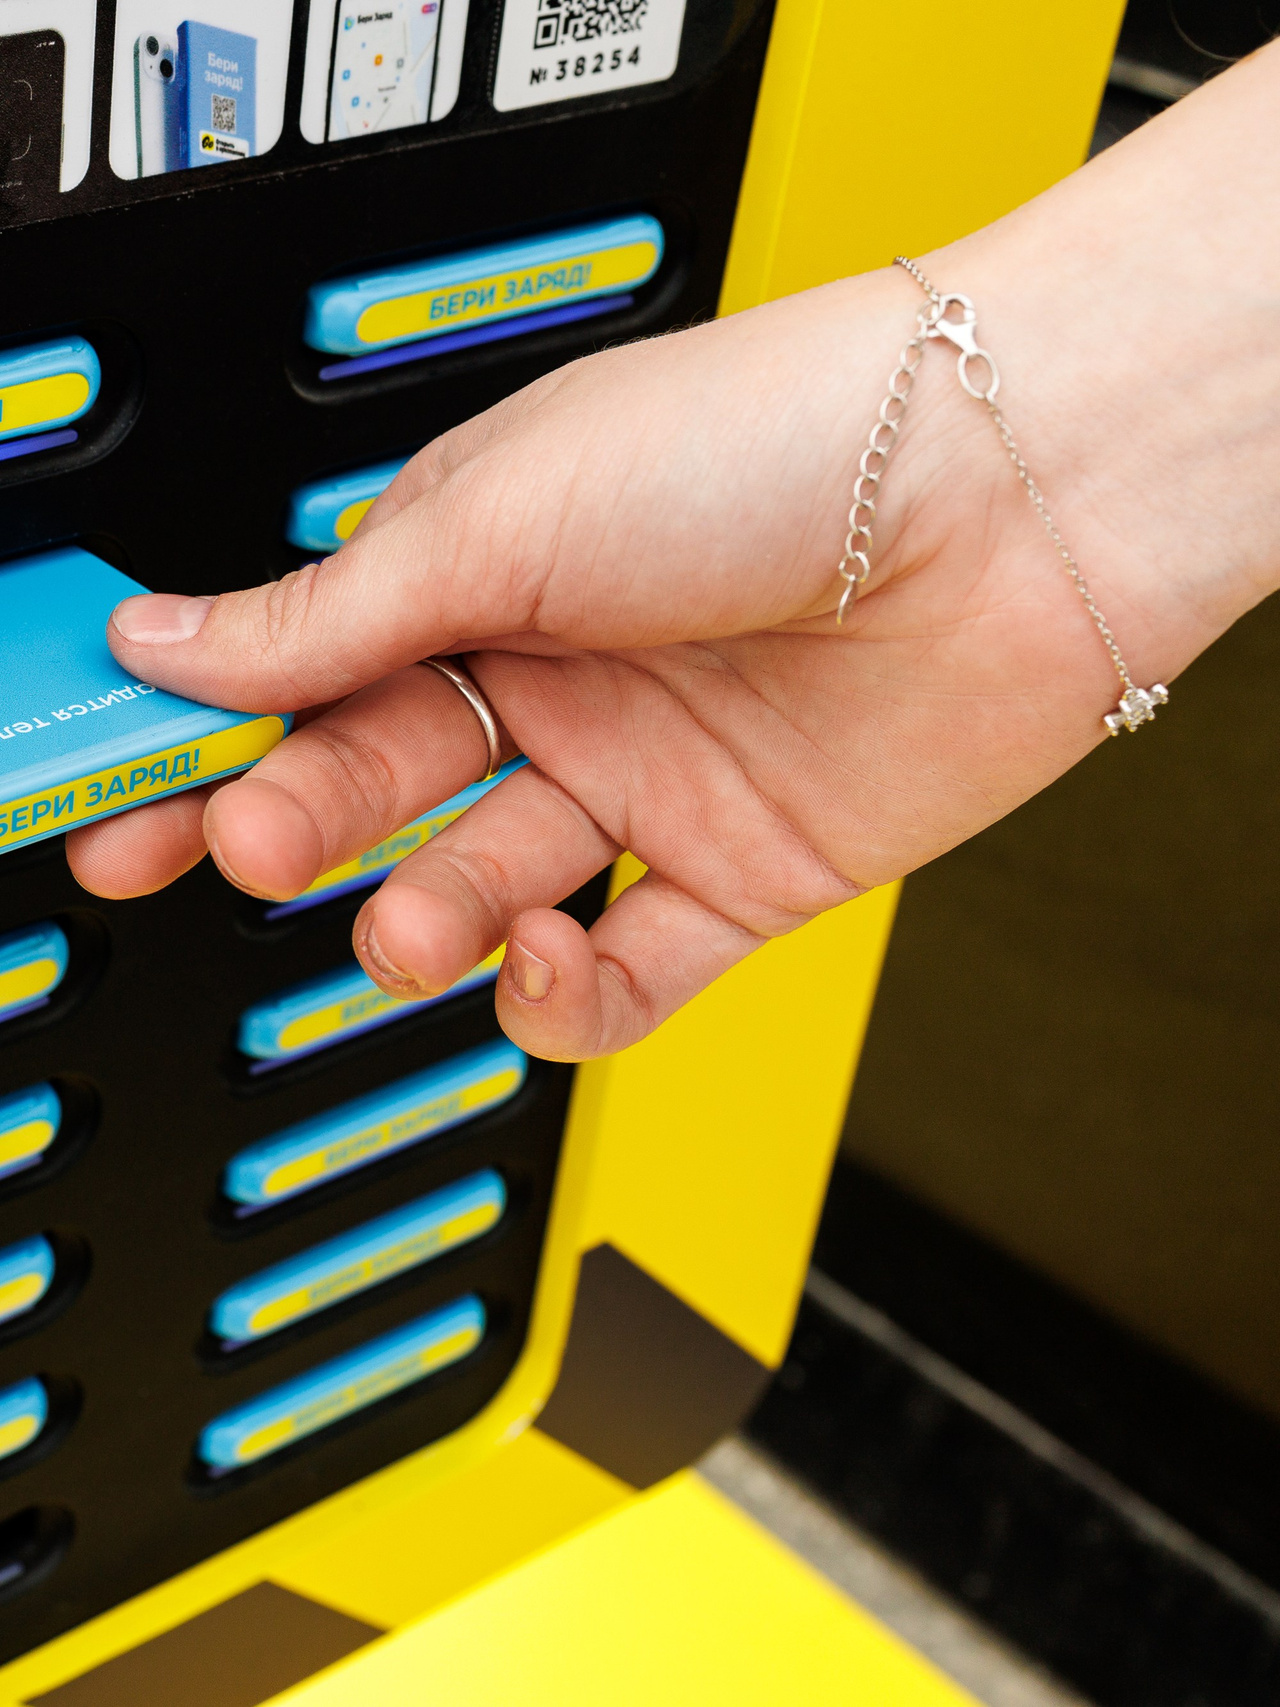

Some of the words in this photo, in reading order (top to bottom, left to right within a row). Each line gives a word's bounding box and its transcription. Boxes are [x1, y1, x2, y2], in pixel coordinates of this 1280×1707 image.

[208, 52, 238, 73] Бери
[555, 45, 640, 81] 38254
[204, 70, 243, 92] заряд!
[202, 136, 214, 149] Go
[429, 284, 497, 320] БЕРИ
[503, 262, 592, 303] ЗАРЯД!
[51, 683, 156, 722] адится
[85, 748, 200, 807] ЗАРЯД!
